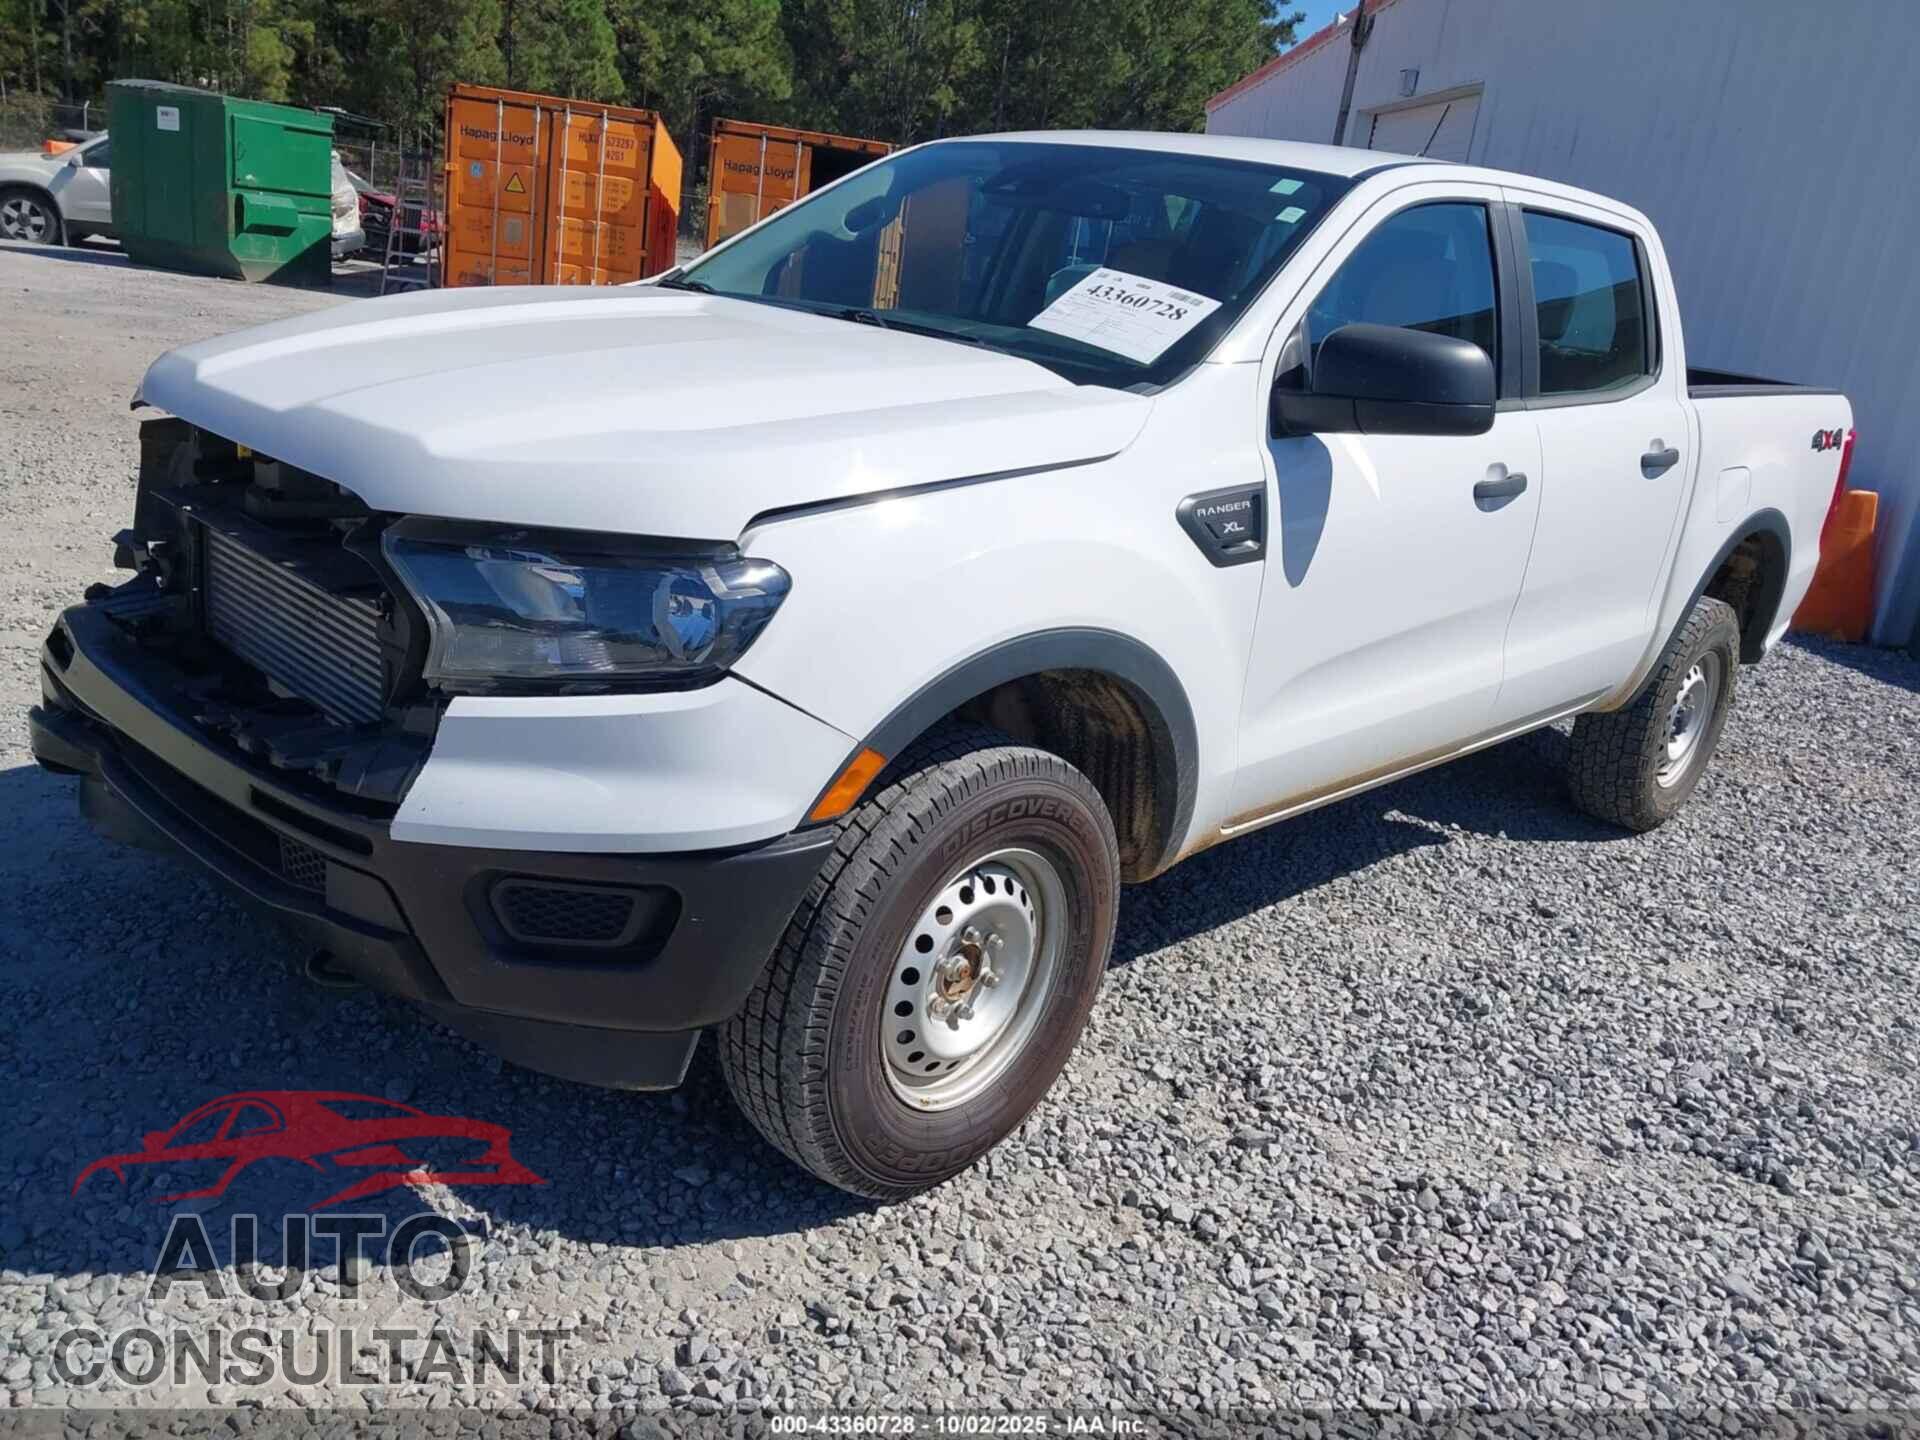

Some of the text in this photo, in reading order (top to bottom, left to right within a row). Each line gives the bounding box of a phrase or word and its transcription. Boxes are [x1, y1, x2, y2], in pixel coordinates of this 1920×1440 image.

[501, 130, 534, 146] Lloyd
[1087, 284, 1188, 320] 43360728
[1197, 501, 1251, 517] RANGER
[1222, 522, 1245, 534] XL
